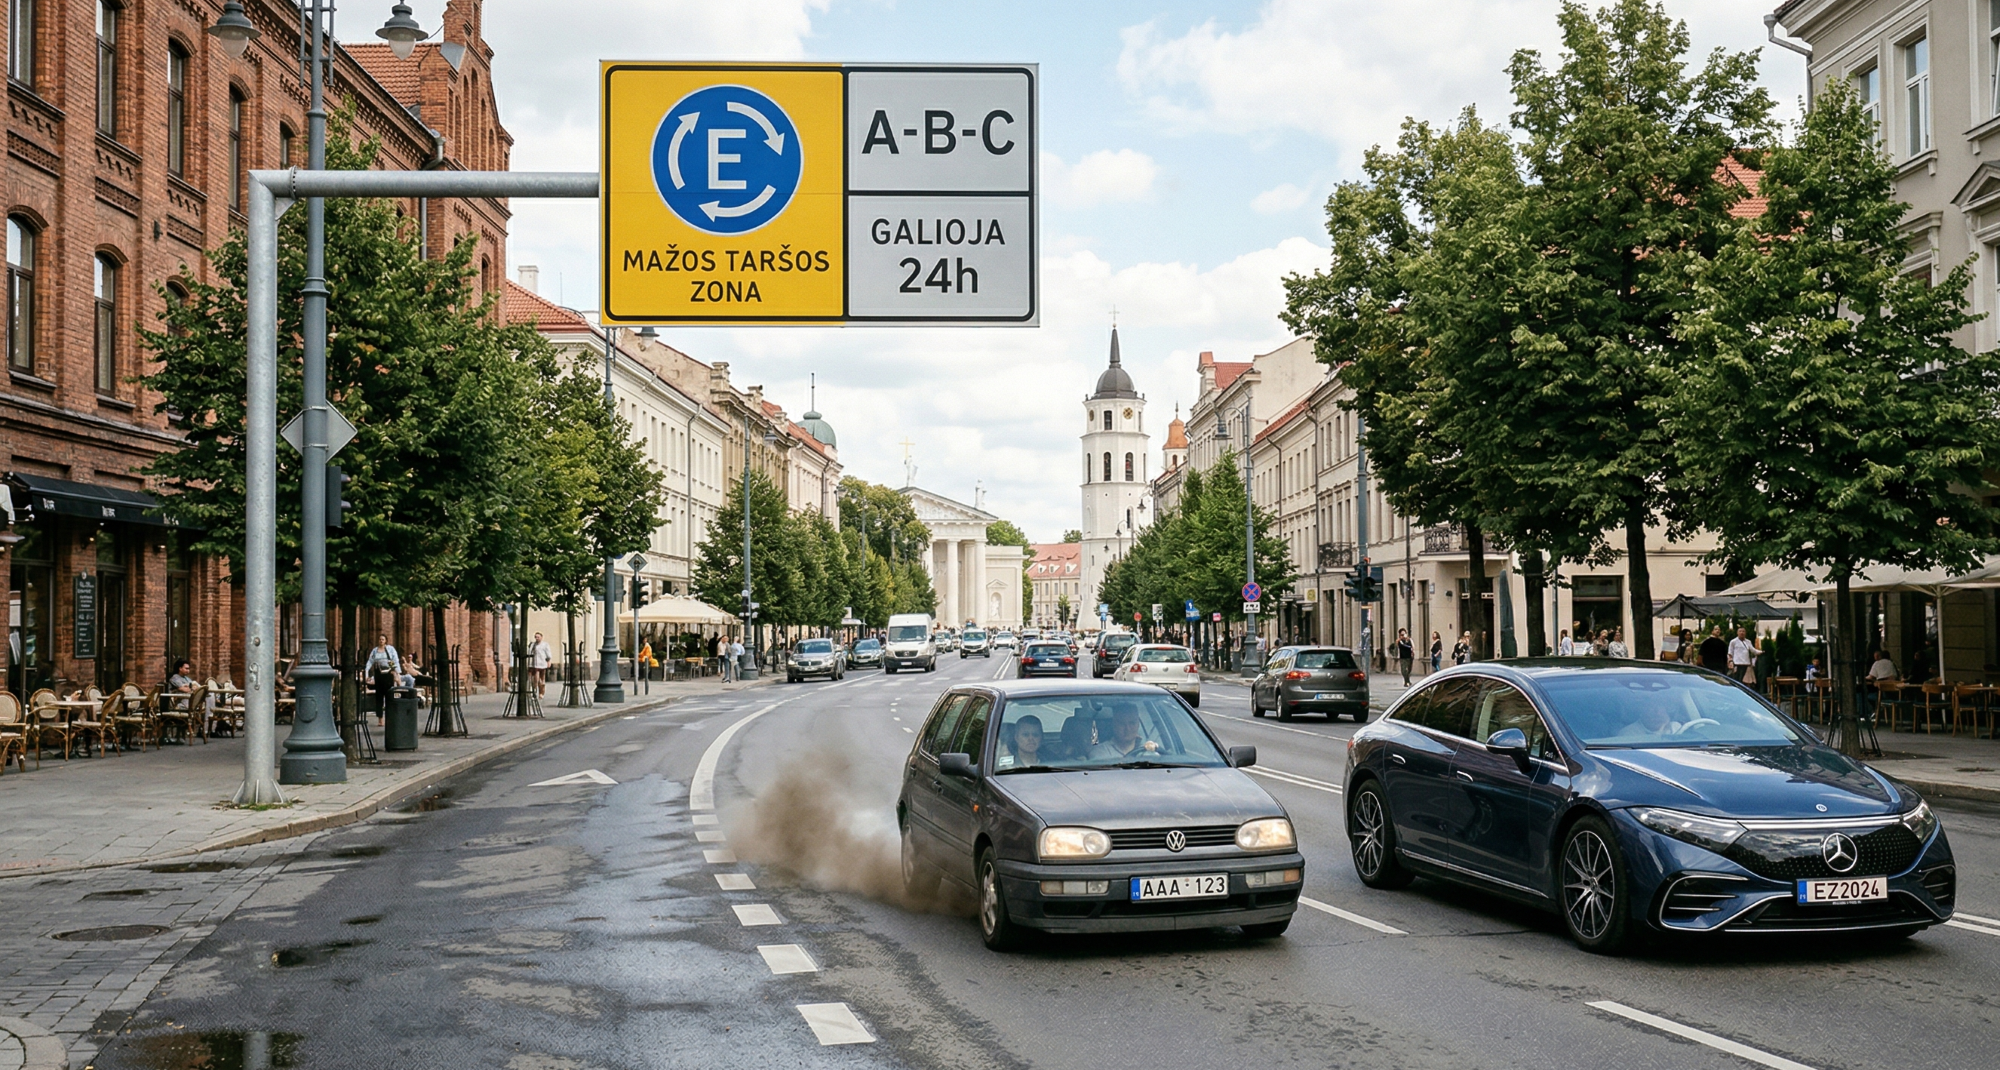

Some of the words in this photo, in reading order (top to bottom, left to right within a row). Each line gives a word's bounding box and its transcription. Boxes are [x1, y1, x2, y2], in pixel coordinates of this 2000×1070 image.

[861, 109, 1015, 156] A-B-C
[708, 128, 747, 190] E
[871, 218, 1006, 246] GALIOJA
[623, 243, 716, 272] MAŽOS
[725, 244, 830, 272] TARŠOS
[898, 257, 979, 294] 24h
[690, 281, 762, 303] ZONA
[1143, 879, 1181, 897] AAA
[1195, 876, 1225, 894] 123
[1814, 879, 1880, 900] EZ2024
